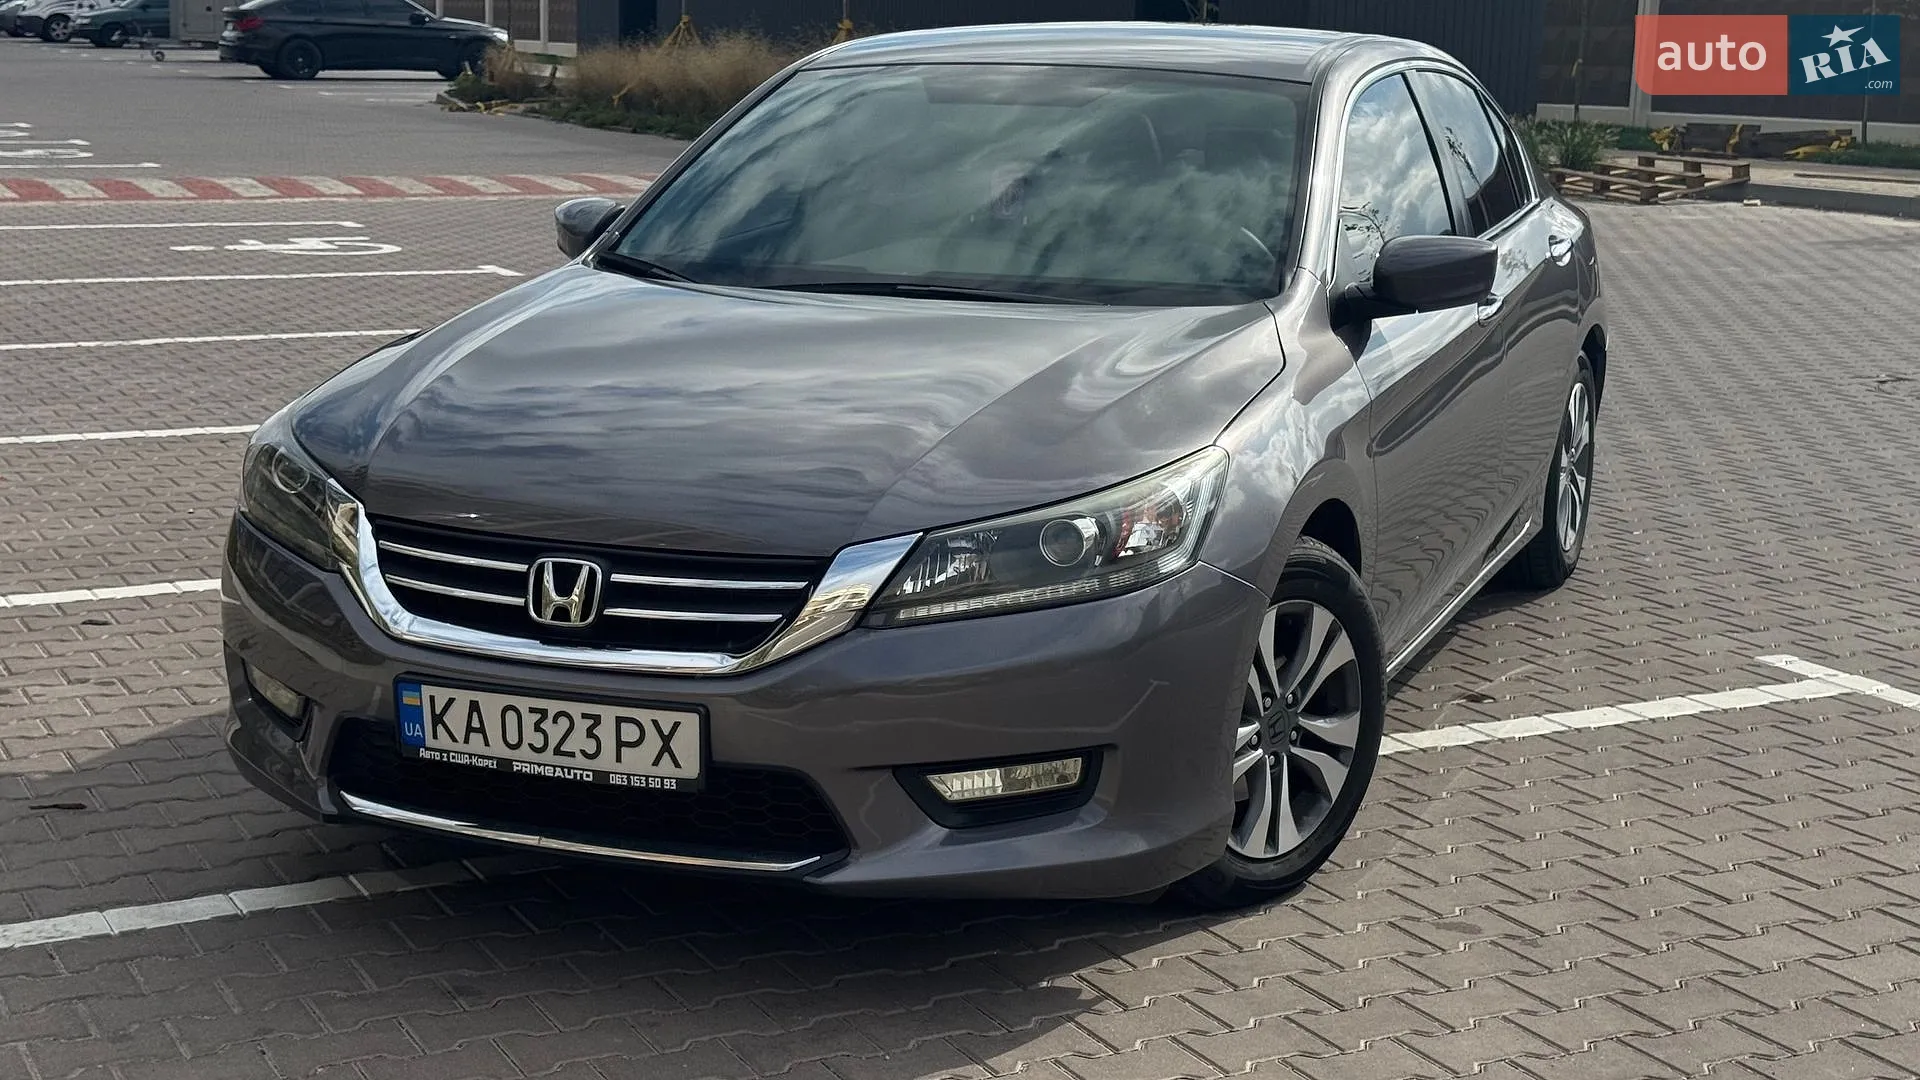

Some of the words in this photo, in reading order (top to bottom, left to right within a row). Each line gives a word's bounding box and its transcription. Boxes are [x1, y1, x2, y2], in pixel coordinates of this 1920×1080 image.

[404, 721, 424, 738] UA
[428, 694, 491, 748] KA
[501, 703, 602, 760] 0323
[615, 715, 682, 769] PX
[609, 773, 628, 786] 063
[630, 774, 646, 787] 153
[648, 776, 661, 789] 50
[663, 778, 677, 790] 93
